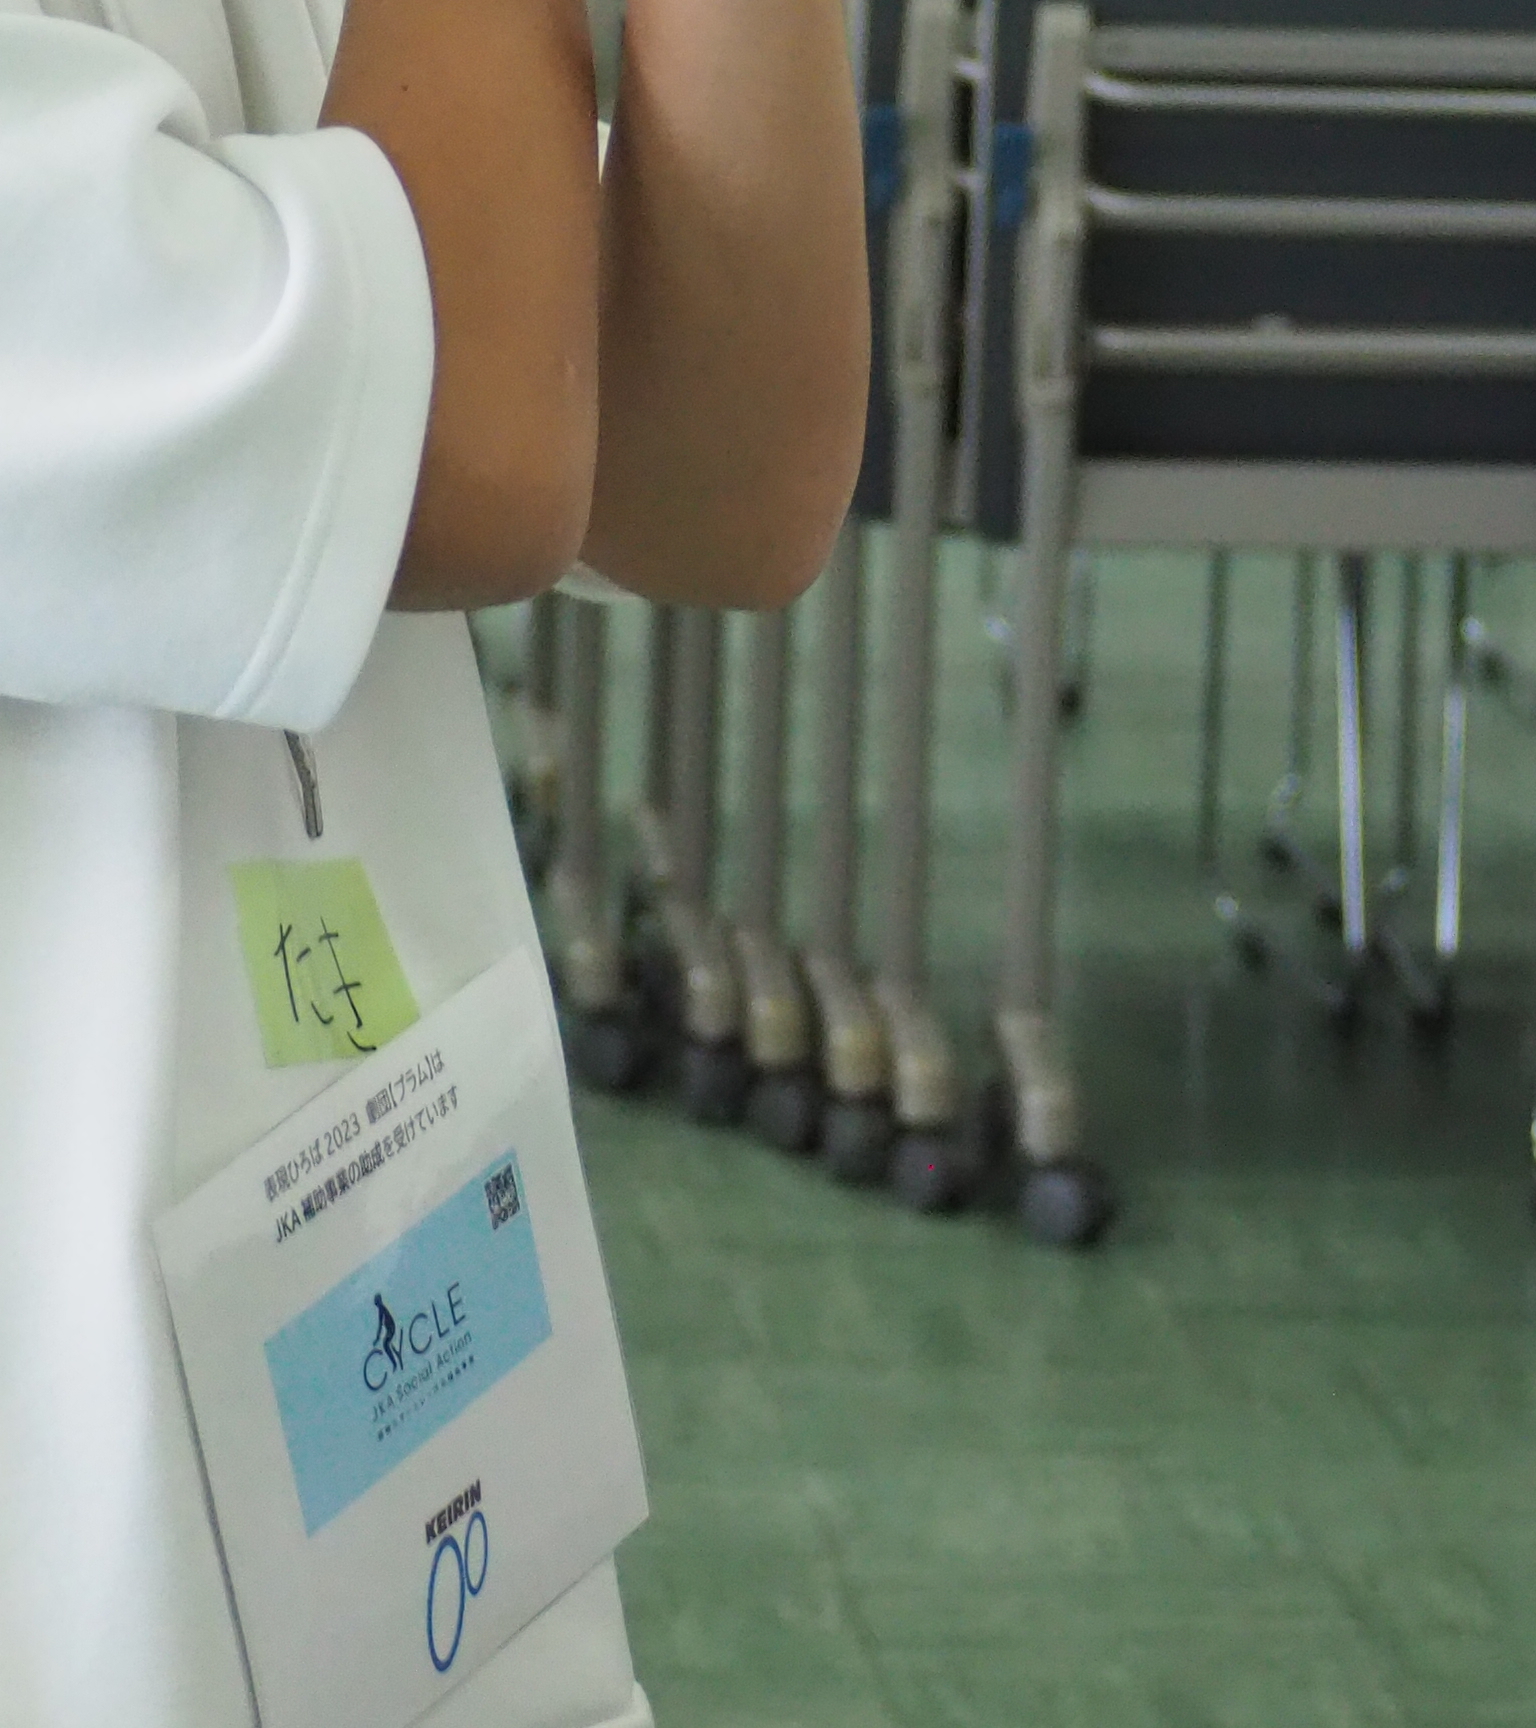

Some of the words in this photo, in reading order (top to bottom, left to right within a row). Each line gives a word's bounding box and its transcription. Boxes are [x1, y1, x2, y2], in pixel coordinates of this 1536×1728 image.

[273, 915, 377, 1052] たき
[323, 1112, 362, 1156] 2023
[276, 1206, 302, 1243] JKA
[363, 1282, 466, 1391] CYCLE
[372, 1395, 395, 1422] JKA
[425, 1478, 482, 1545] KEIRIN
